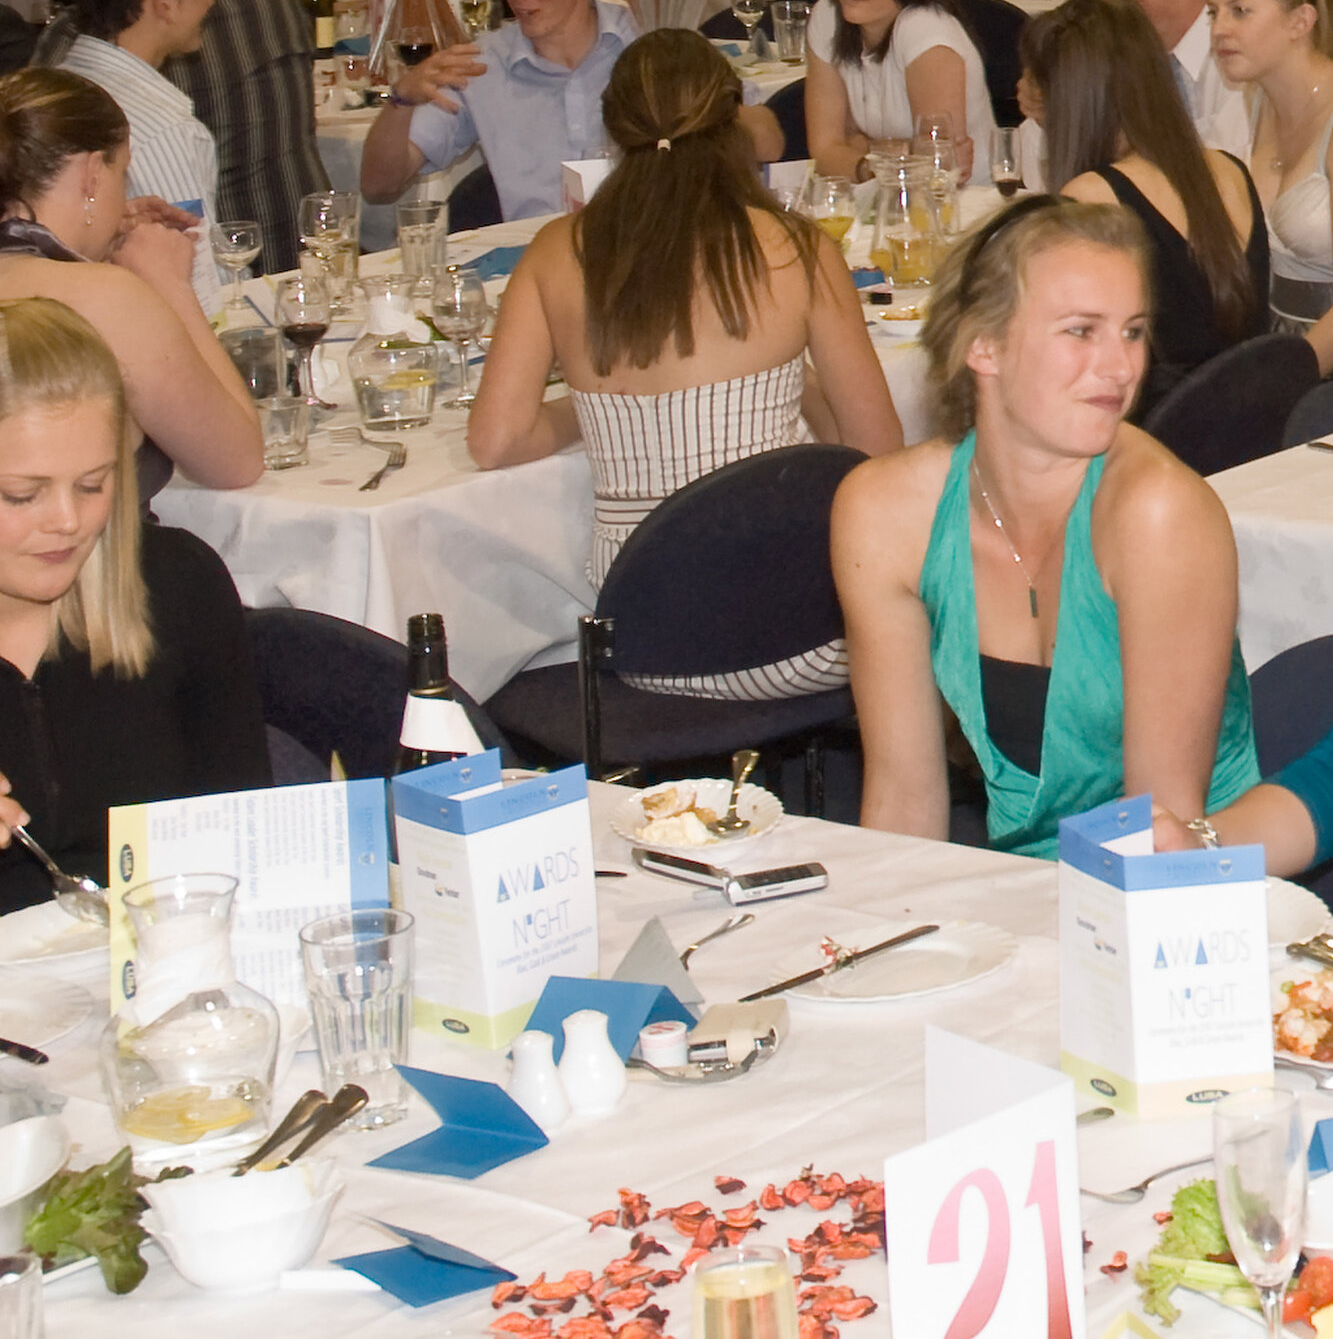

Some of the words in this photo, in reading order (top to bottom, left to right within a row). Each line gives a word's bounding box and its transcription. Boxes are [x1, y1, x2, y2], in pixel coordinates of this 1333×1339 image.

[496, 846, 580, 904] AWARDS
[1154, 928, 1252, 969] AWARDS
[926, 1139, 1074, 1339] 21
